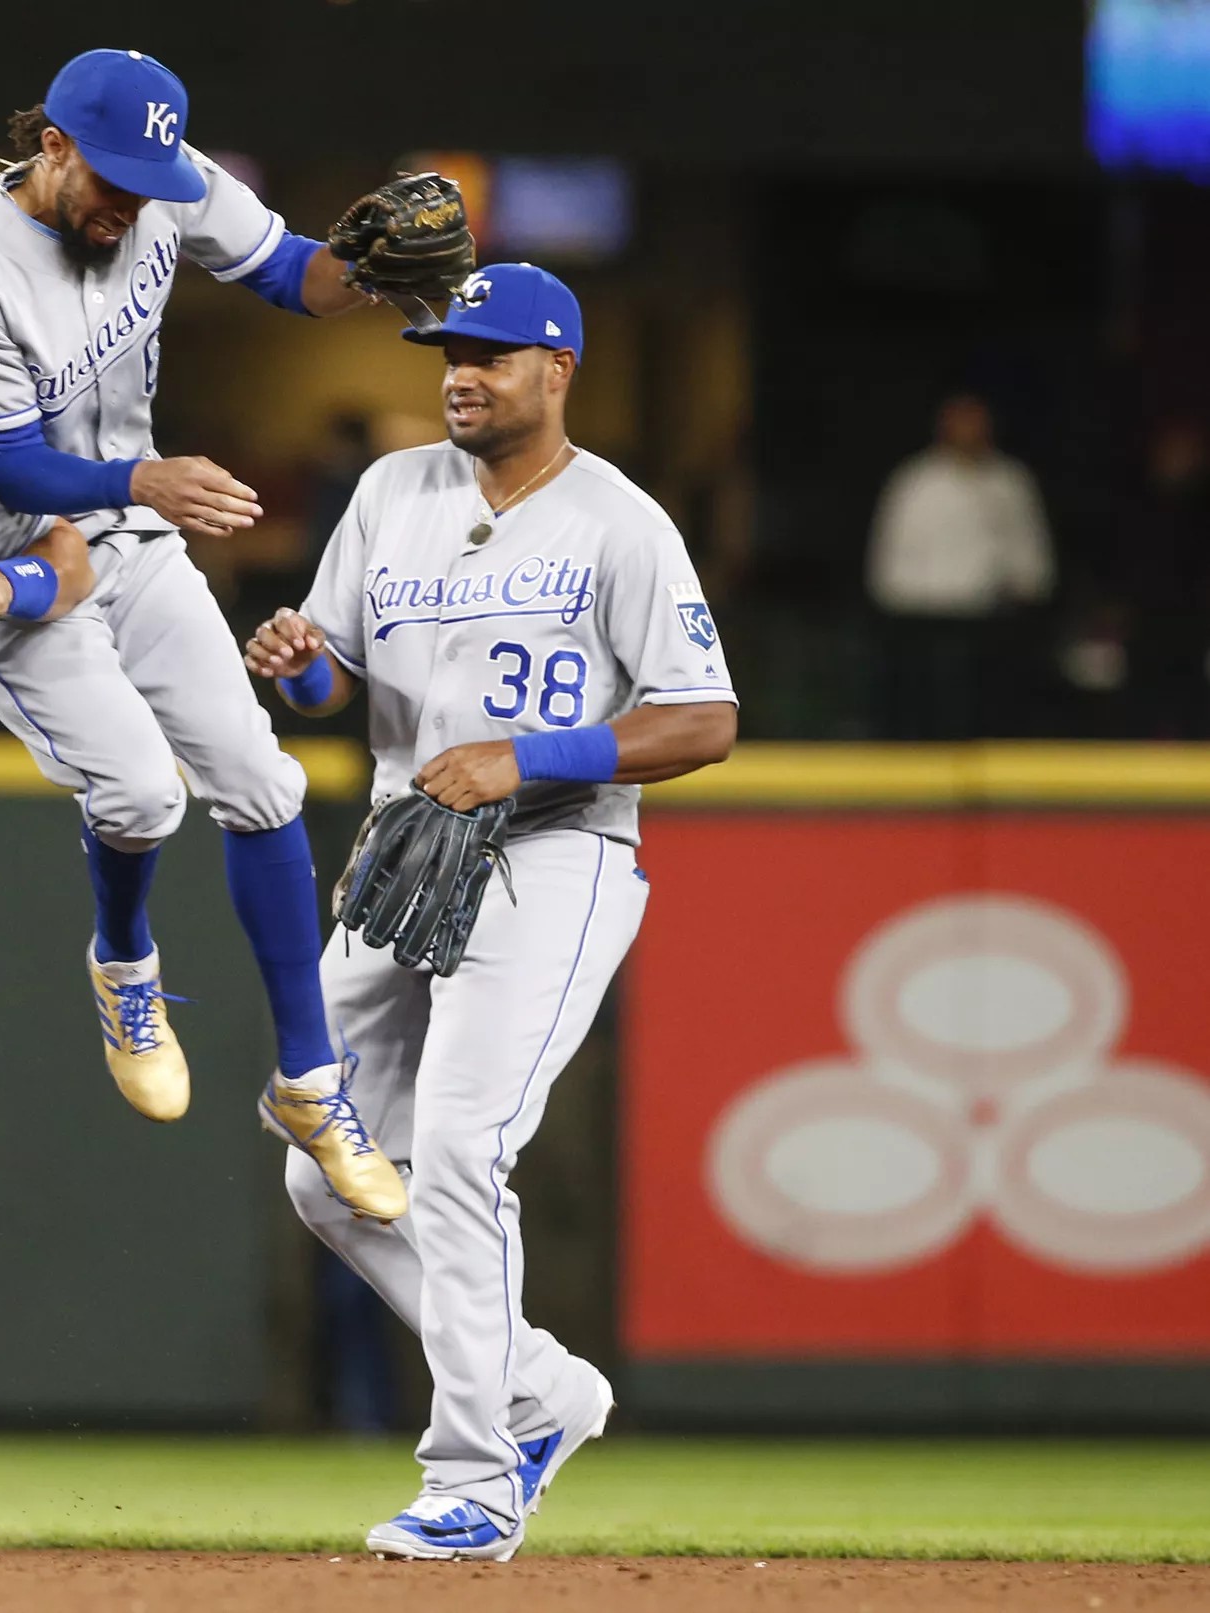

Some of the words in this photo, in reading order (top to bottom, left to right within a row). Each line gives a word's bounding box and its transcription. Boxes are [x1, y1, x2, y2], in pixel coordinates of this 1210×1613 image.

[143, 101, 178, 146] KC
[365, 565, 494, 620] Kansas
[500, 556, 595, 626] City
[679, 607, 715, 642] KC
[482, 640, 588, 728] 38
